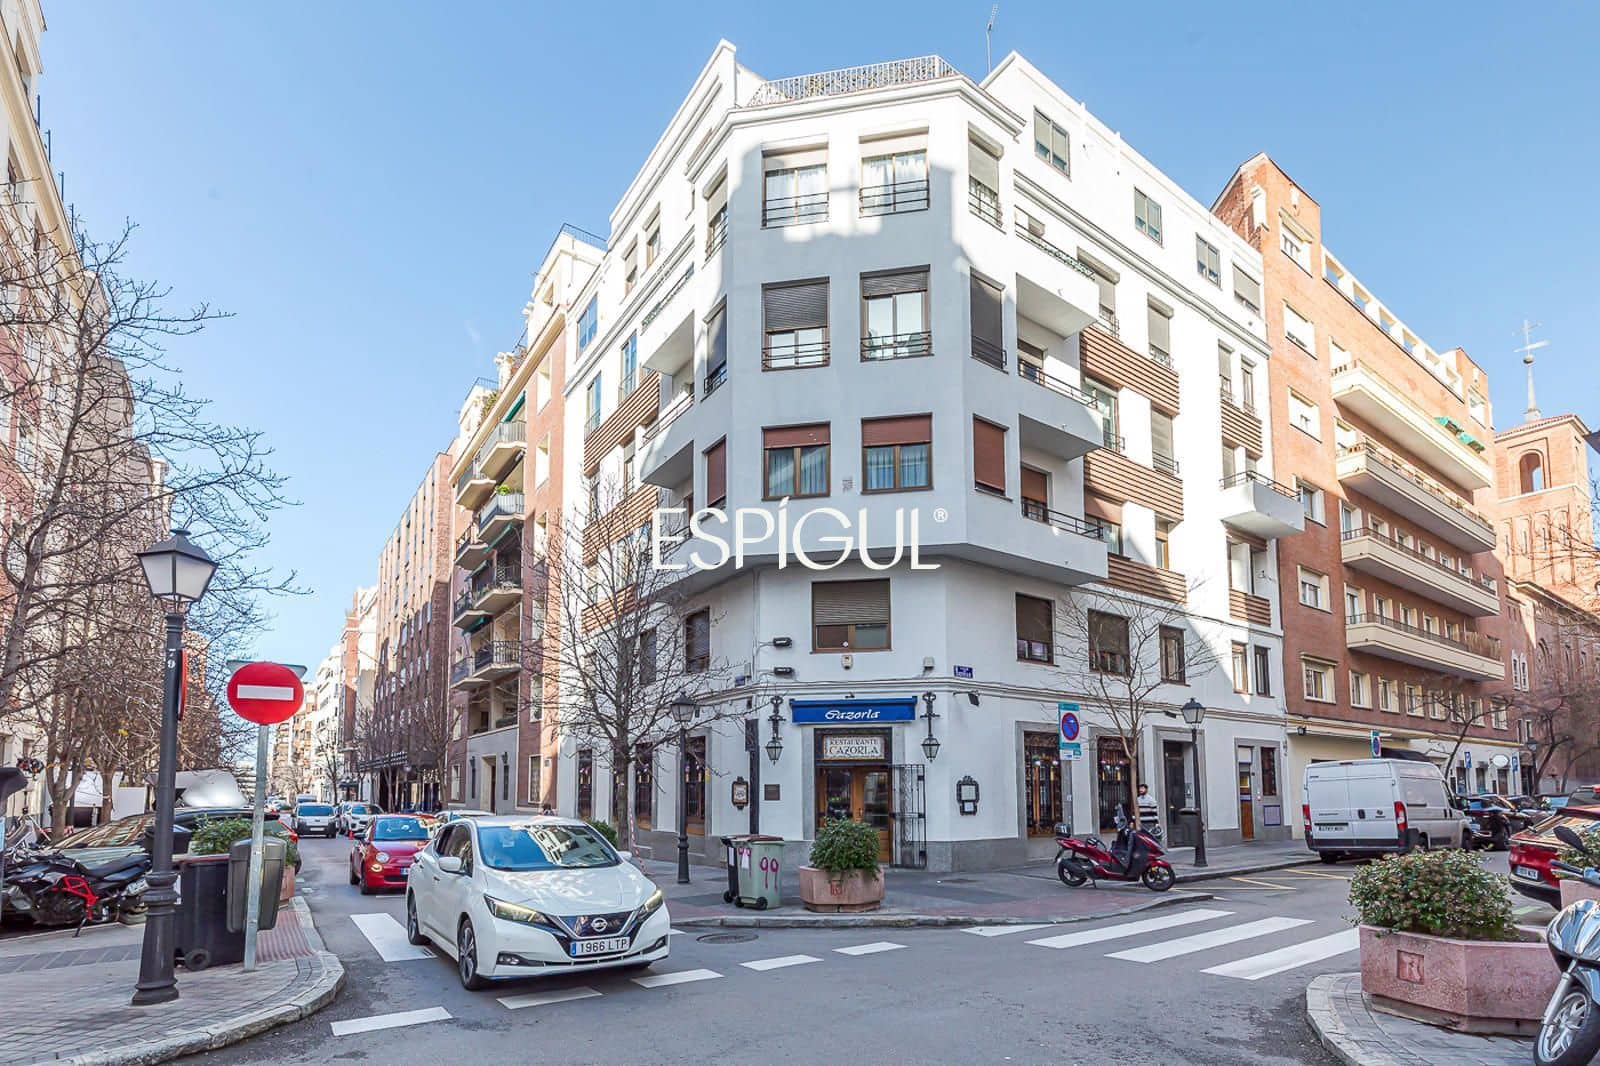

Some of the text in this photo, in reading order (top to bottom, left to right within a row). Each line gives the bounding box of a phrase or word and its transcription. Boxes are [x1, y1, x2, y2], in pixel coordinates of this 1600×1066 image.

[829, 745, 880, 755] CAZORLA
[580, 938, 628, 953] 1966 LTP
